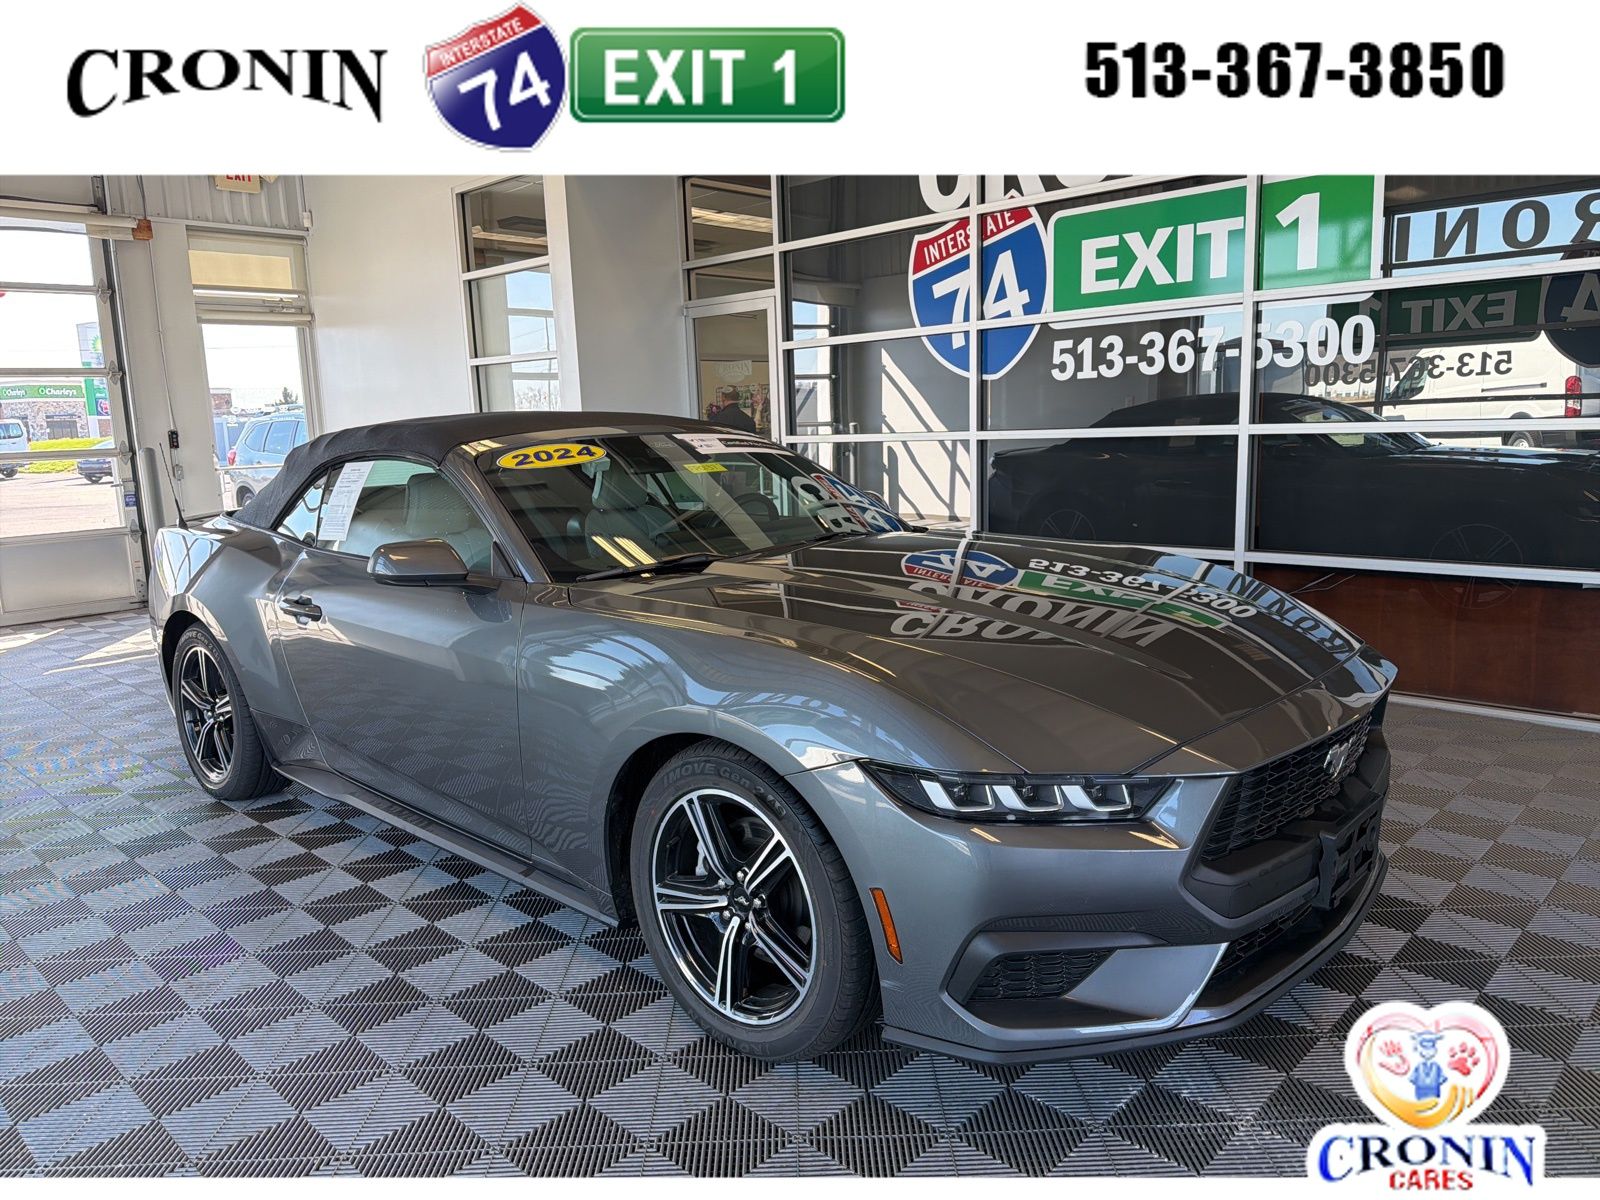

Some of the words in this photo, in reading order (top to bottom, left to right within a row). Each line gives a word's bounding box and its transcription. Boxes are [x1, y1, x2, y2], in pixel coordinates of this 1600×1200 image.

[1081, 215, 1244, 295] EXIT
[1275, 191, 1321, 271] 1
[931, 249, 1031, 351] 74
[1050, 314, 1376, 381] 513-367-5300
[511, 446, 596, 467] 2024
[662, 762, 718, 786] IMOVE
[718, 765, 750, 789] Gen
